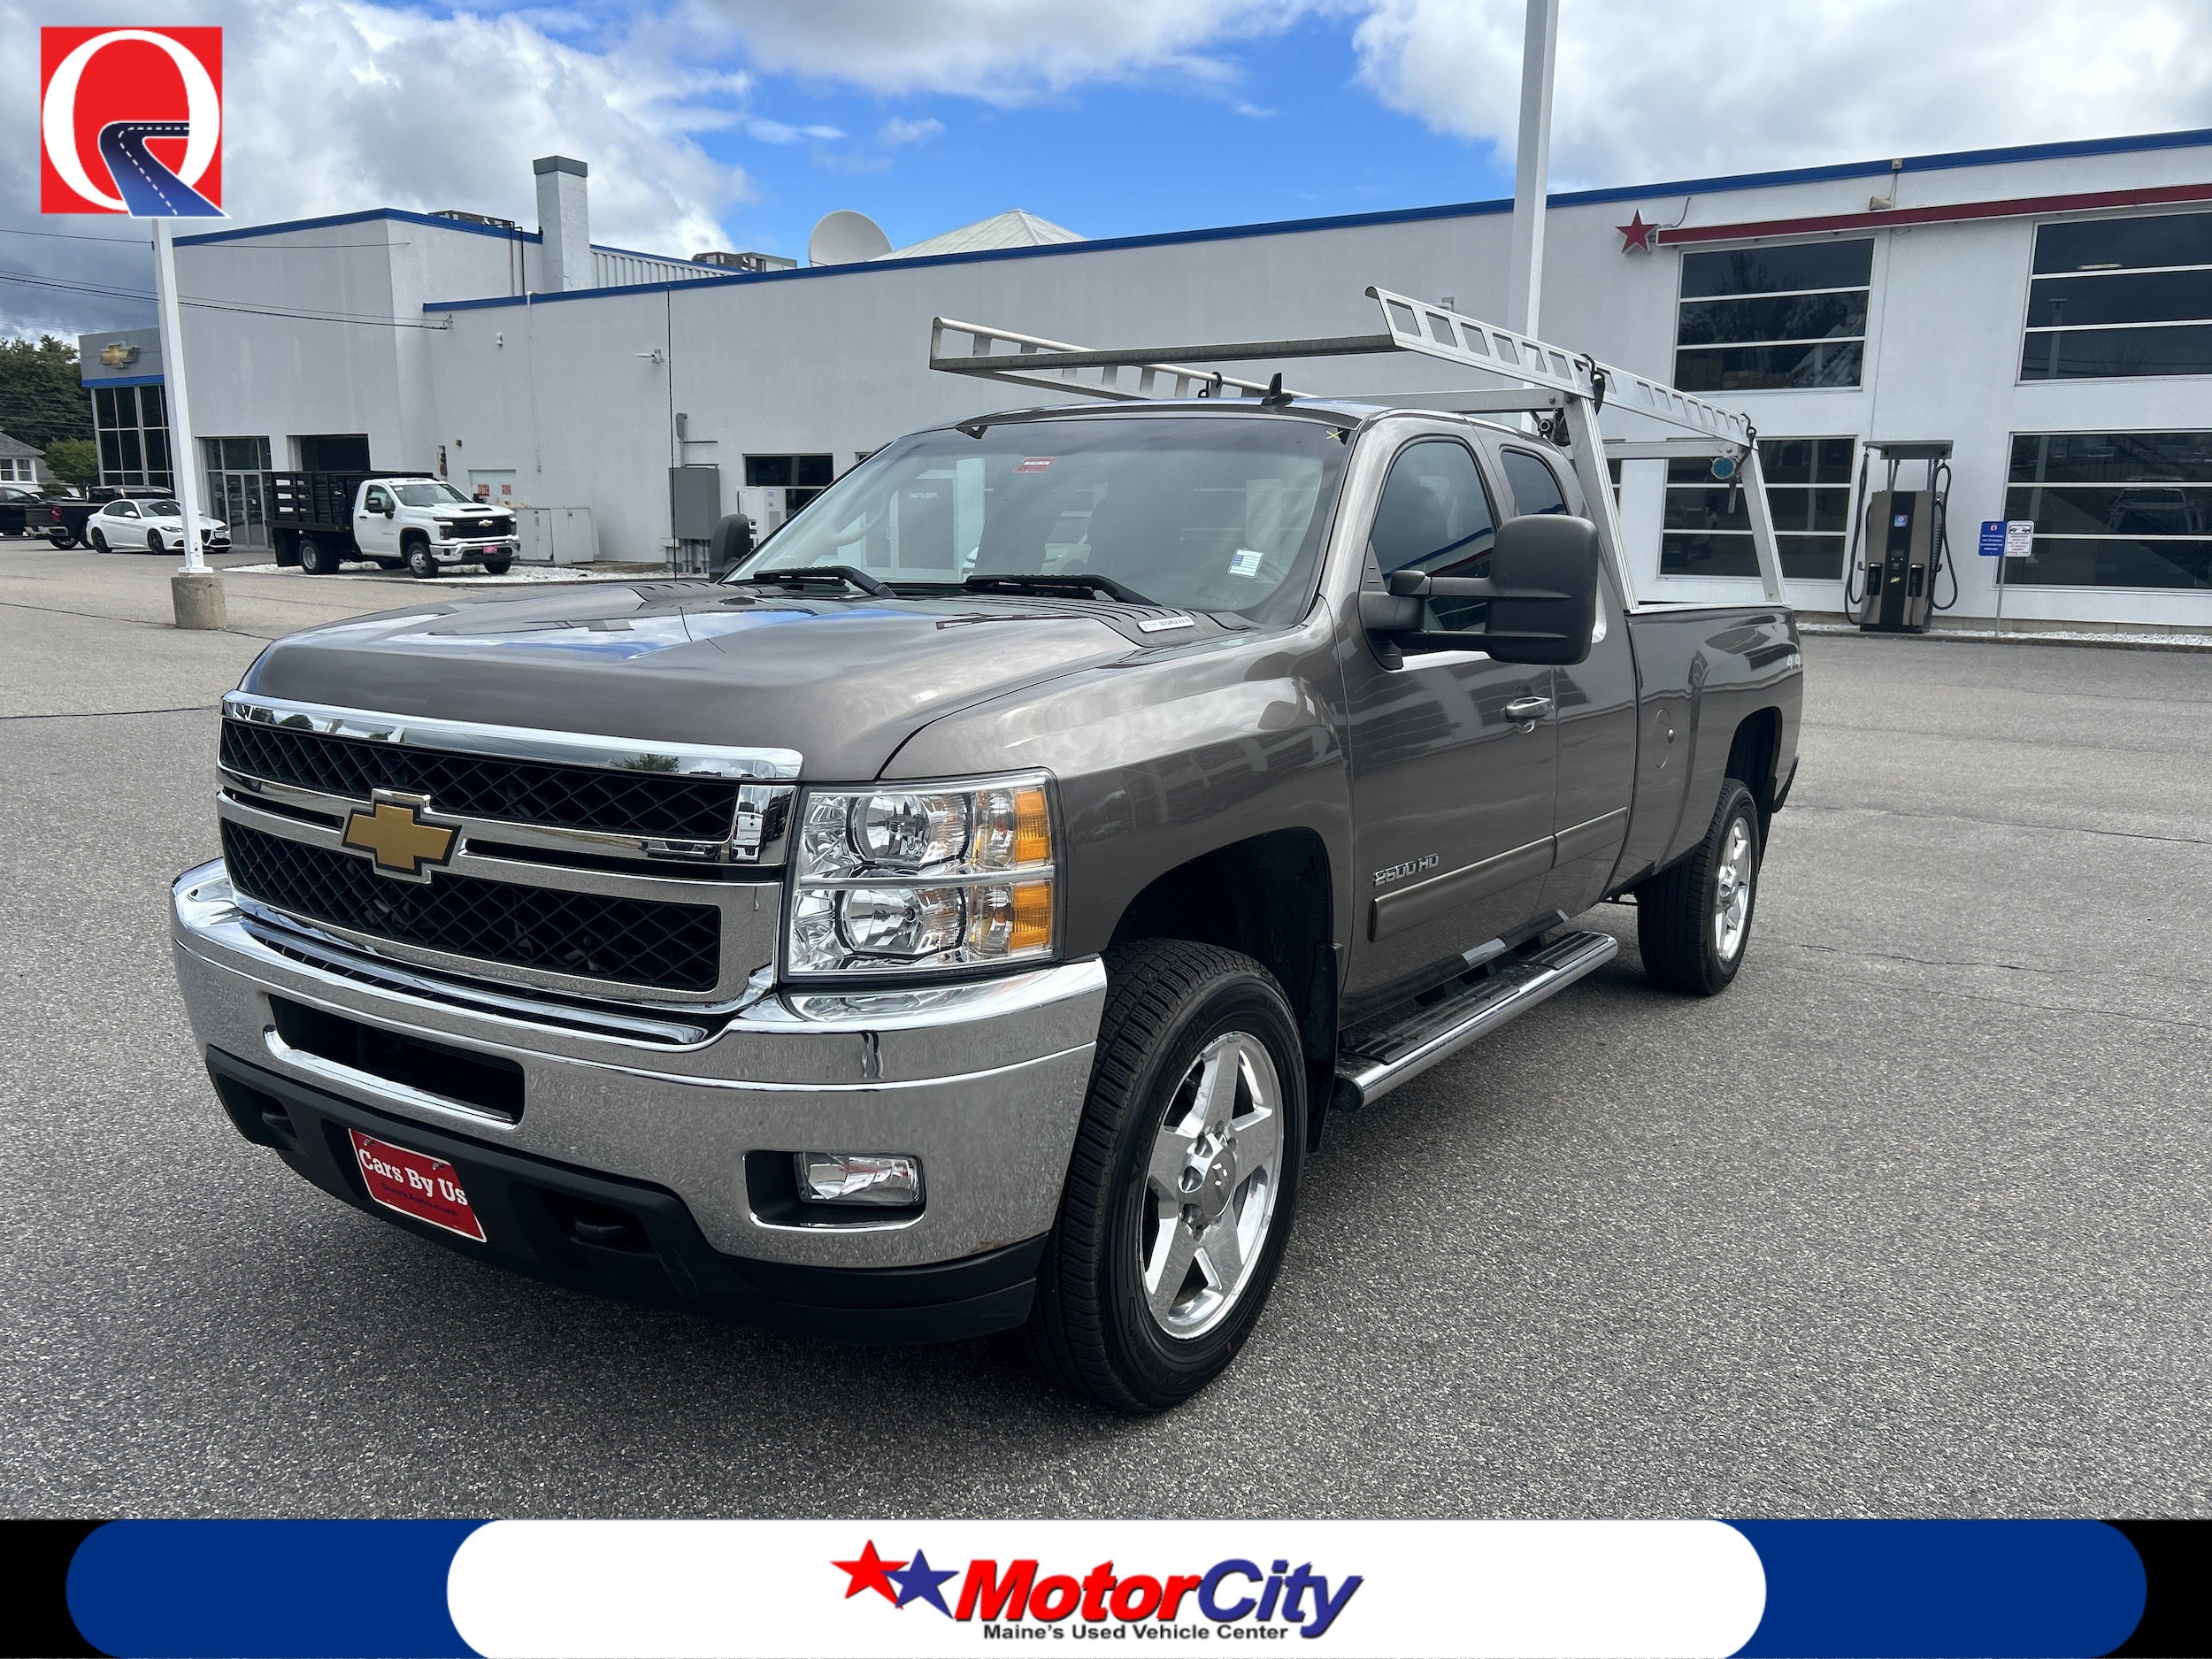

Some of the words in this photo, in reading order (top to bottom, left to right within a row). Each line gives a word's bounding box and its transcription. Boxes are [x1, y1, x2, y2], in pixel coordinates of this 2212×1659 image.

[1373, 861, 1416, 886] 2500
[1417, 853, 1439, 872] HD
[358, 1148, 404, 1183] Cars
[404, 1167, 433, 1197] By
[437, 1178, 468, 1206] Us
